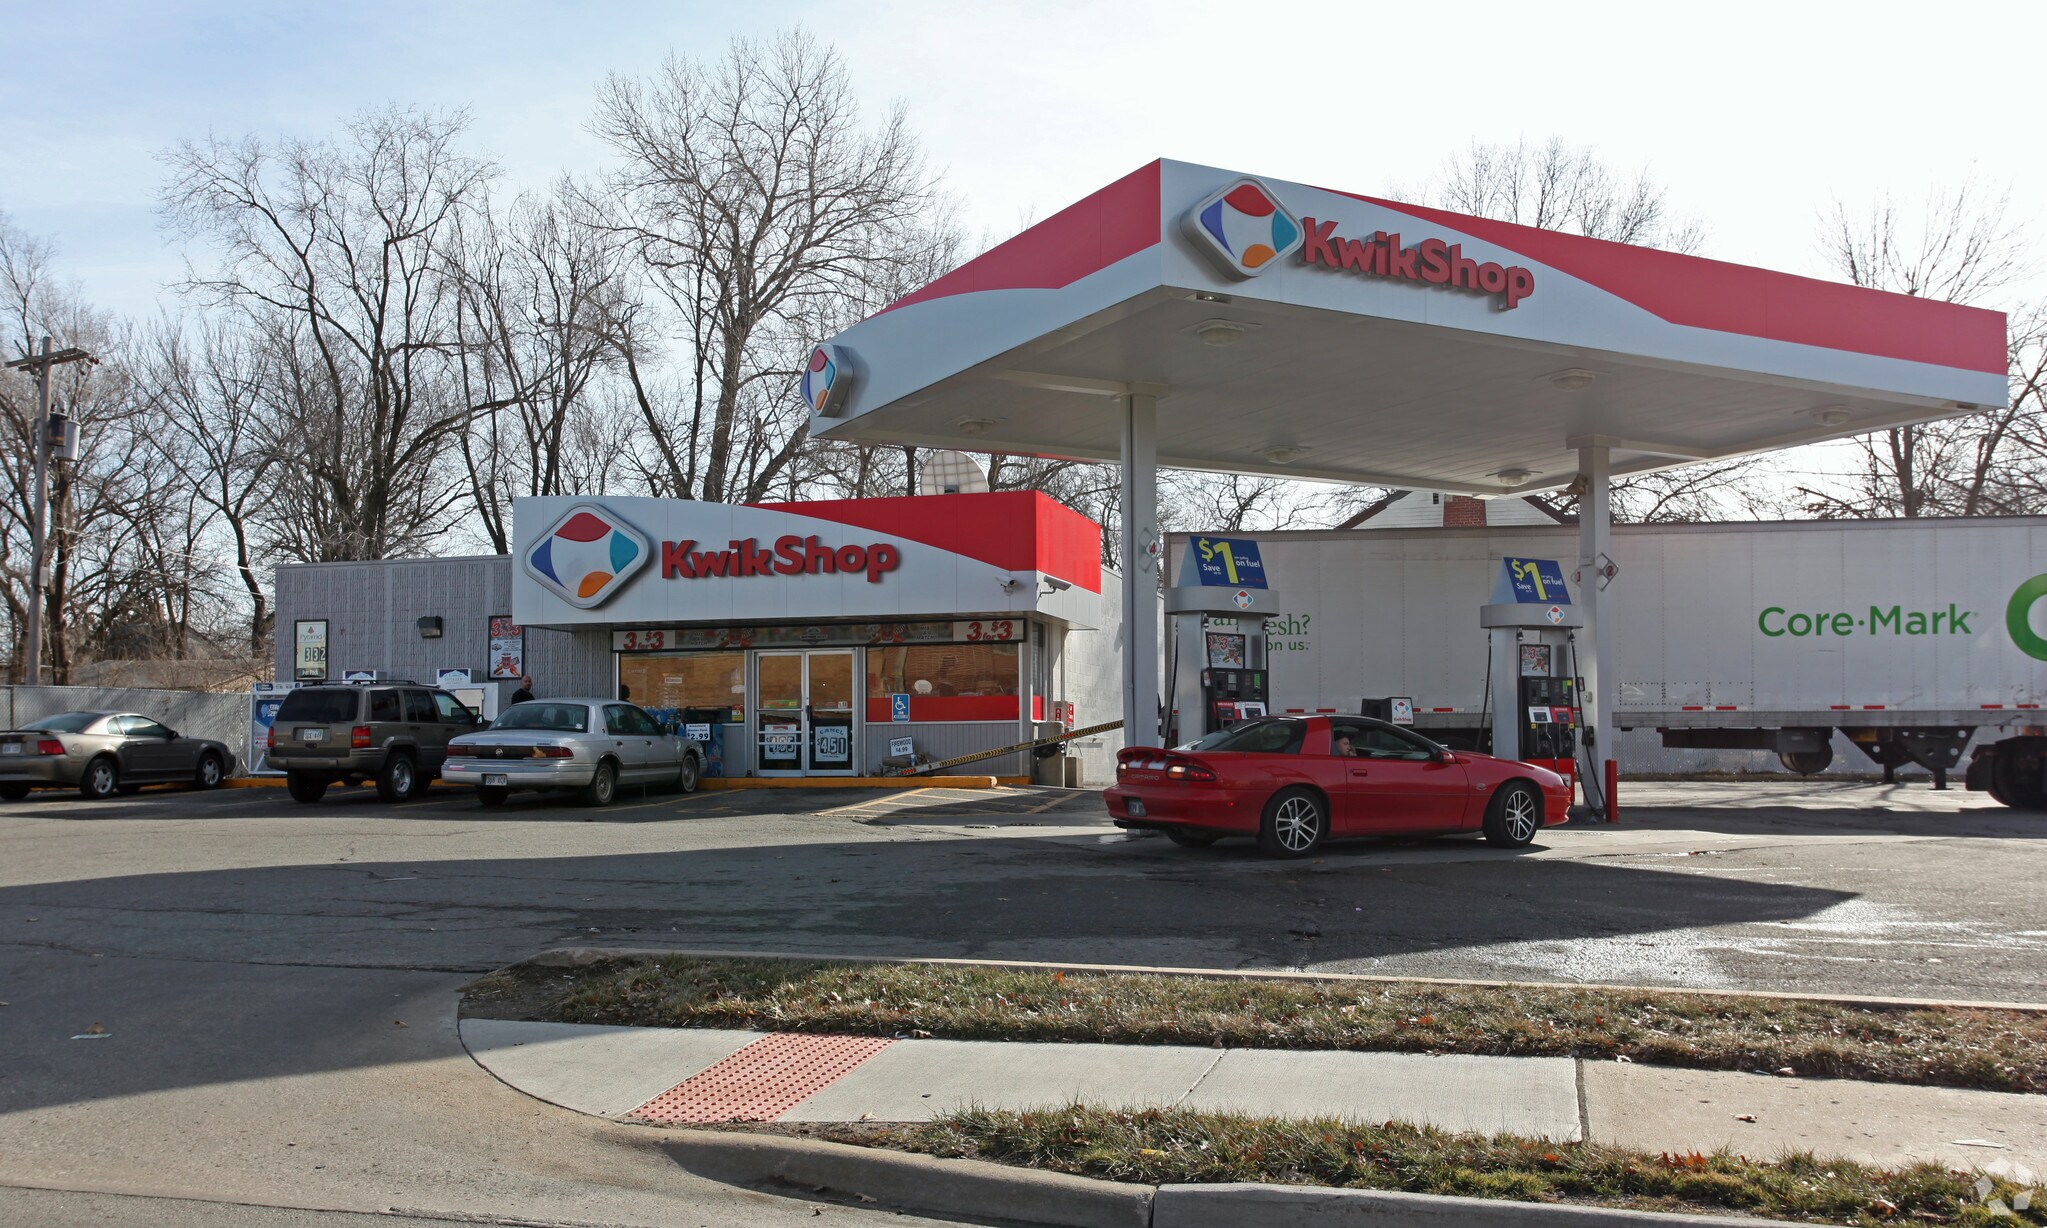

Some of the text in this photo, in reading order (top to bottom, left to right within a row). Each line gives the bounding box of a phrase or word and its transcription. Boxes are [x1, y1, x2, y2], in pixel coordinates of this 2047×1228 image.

[1302, 216, 1535, 309] KwikShop
[662, 535, 899, 583] KwikShop
[1198, 538, 1239, 584] $1
[1246, 559, 1261, 568] fuel
[1202, 563, 1221, 572] Save
[1605, 565, 1615, 577] 2
[1511, 559, 1548, 600] $1
[1551, 578, 1563, 586] fuel
[1516, 582, 1532, 590] Save
[966, 621, 983, 641] 3
[990, 619, 1013, 640] $3
[1267, 614, 1311, 636] esh?
[623, 631, 638, 651] 3
[644, 630, 665, 650] $3
[687, 732, 709, 740] $2.99
[820, 728, 844, 736] CAMEL
[891, 738, 912, 747] FIREWOOD
